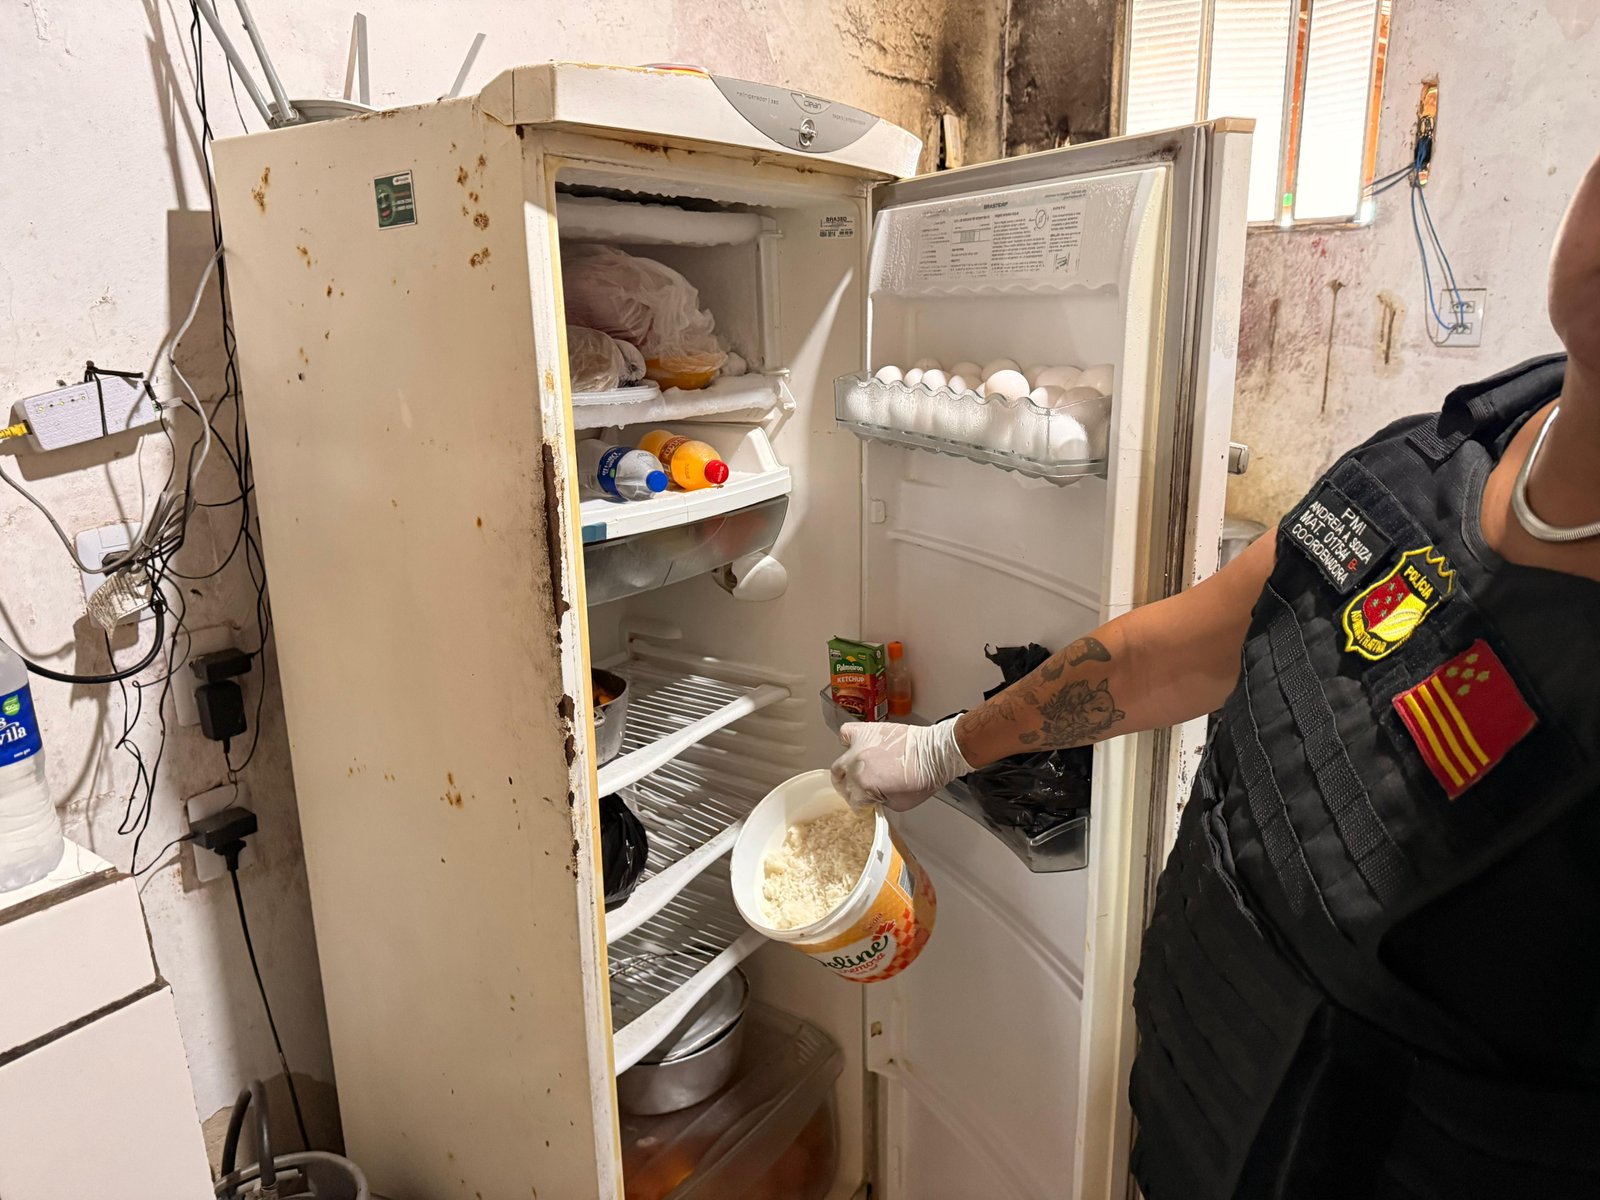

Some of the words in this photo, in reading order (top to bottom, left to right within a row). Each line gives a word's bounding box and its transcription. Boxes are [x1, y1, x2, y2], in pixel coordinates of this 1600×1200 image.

[1300, 509, 1326, 536] MAT.
[1323, 531, 1351, 562] 017544
[1309, 501, 1345, 536] ANDREIA
[1341, 531, 1351, 543] A
[1349, 537, 1373, 565] SOUZA
[1341, 507, 1367, 536] PMI
[1291, 523, 1349, 585] COORDENADORA
[1403, 565, 1434, 600] POLÍCIA
[836, 675, 865, 683] KETCHUP
